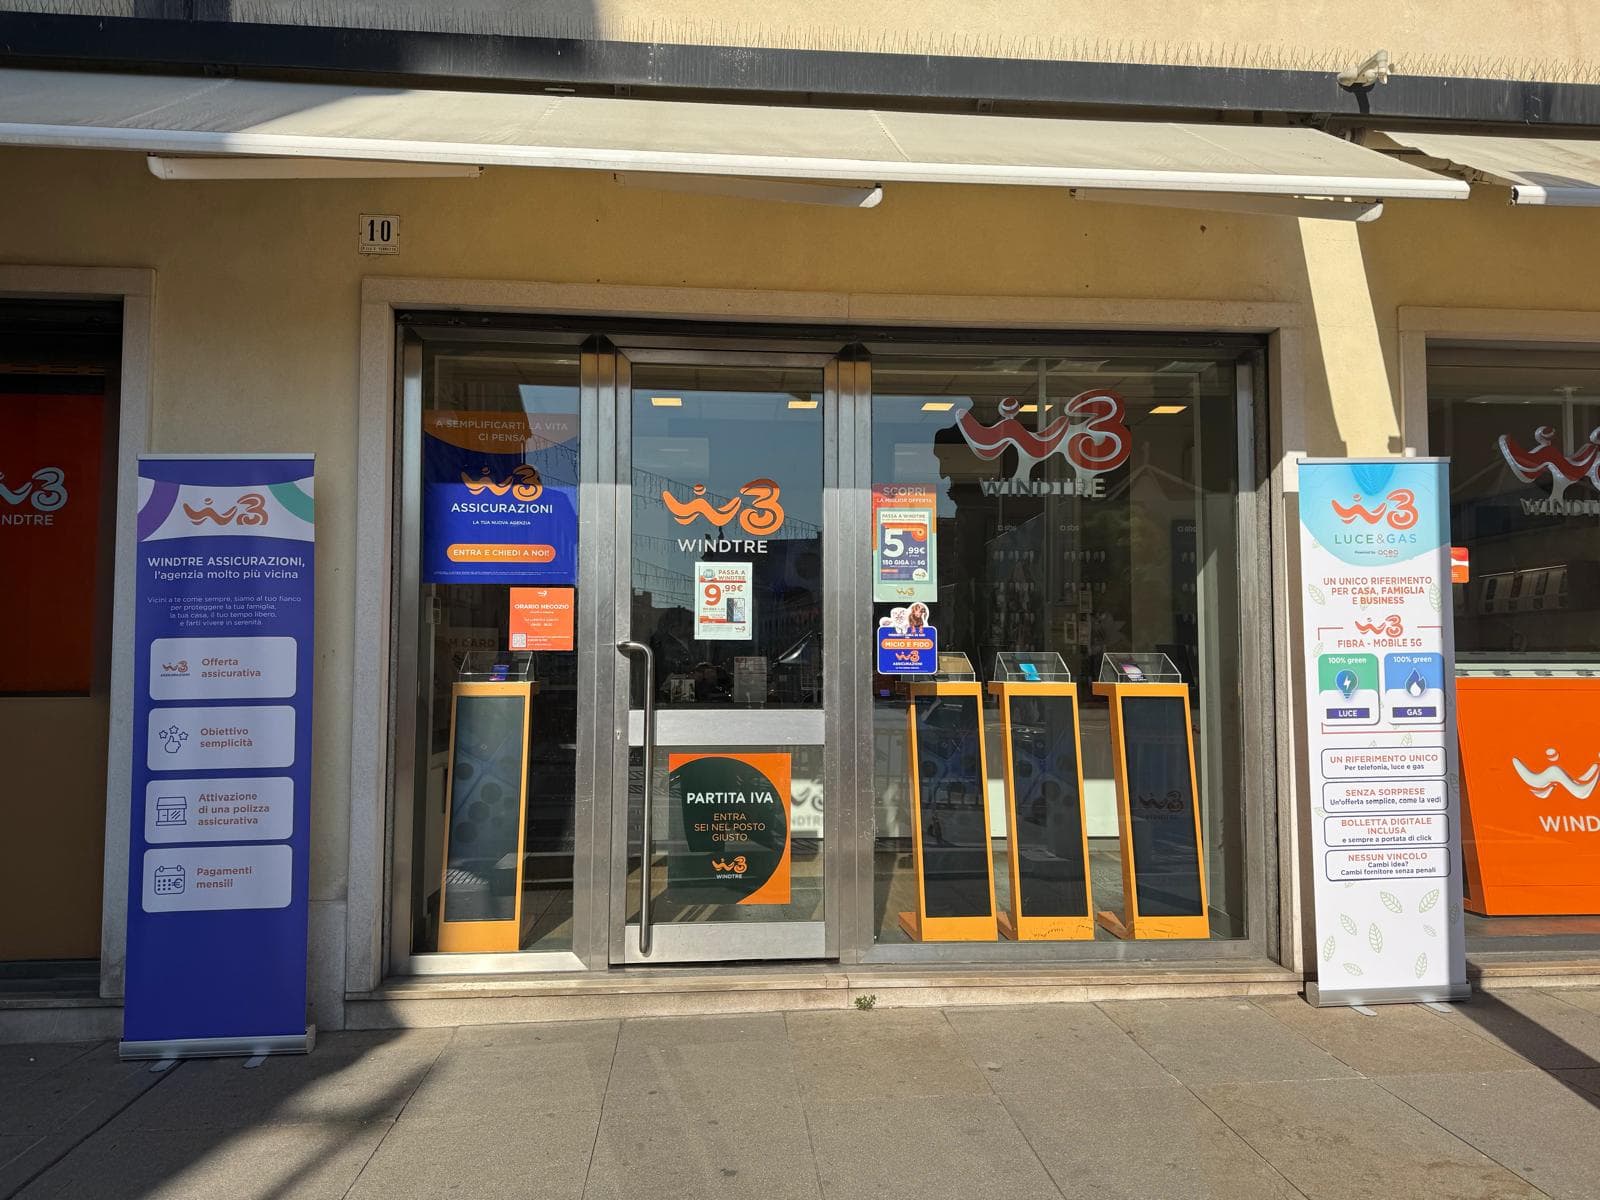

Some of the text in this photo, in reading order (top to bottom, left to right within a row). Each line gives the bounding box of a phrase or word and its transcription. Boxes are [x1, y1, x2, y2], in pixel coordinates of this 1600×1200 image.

[368, 220, 390, 241] 10
[447, 420, 524, 430] SEMPLIFICARTI
[528, 422, 541, 430] LA
[545, 423, 568, 431] VITA
[478, 433, 528, 442] CI PENSA
[883, 487, 926, 496] SCOPRI
[979, 478, 1107, 498] WINDTRE
[451, 503, 553, 514] ASSICURAZIONI
[678, 539, 768, 553] WINDTRE
[148, 556, 305, 568] WINDTRE ASSICURAZIONI,
[154, 569, 298, 581] l'agenzia molto più vicina
[1339, 577, 1368, 585] UNICO
[1371, 577, 1432, 585] RIFERIMENTO
[1332, 587, 1349, 595] PER
[1351, 587, 1378, 595] CASA,
[1360, 596, 1404, 604] BUSINESS
[1338, 640, 1365, 648] FIBRA
[1374, 639, 1408, 647] MOBILE
[1411, 638, 1422, 646] 5G
[201, 658, 238, 666] Offerta
[201, 669, 261, 678] assicurativa
[1407, 708, 1422, 716] GAS
[200, 727, 249, 736] Obiettivo
[200, 738, 253, 748] semplicità
[1346, 755, 1406, 763] RIFERIMENTO
[1378, 788, 1425, 796] SORPRESE
[199, 792, 258, 802] Attivazione
[687, 792, 773, 804] PARTITA IVA
[233, 805, 269, 815] polizza
[198, 817, 258, 826] assicurativa
[714, 813, 746, 821] ENTRA
[712, 823, 730, 831] NEL
[733, 823, 765, 831] POSTO
[1342, 819, 1388, 827] BOLLETTA
[196, 866, 252, 876] Pagamenti
[196, 879, 233, 888] mensili
